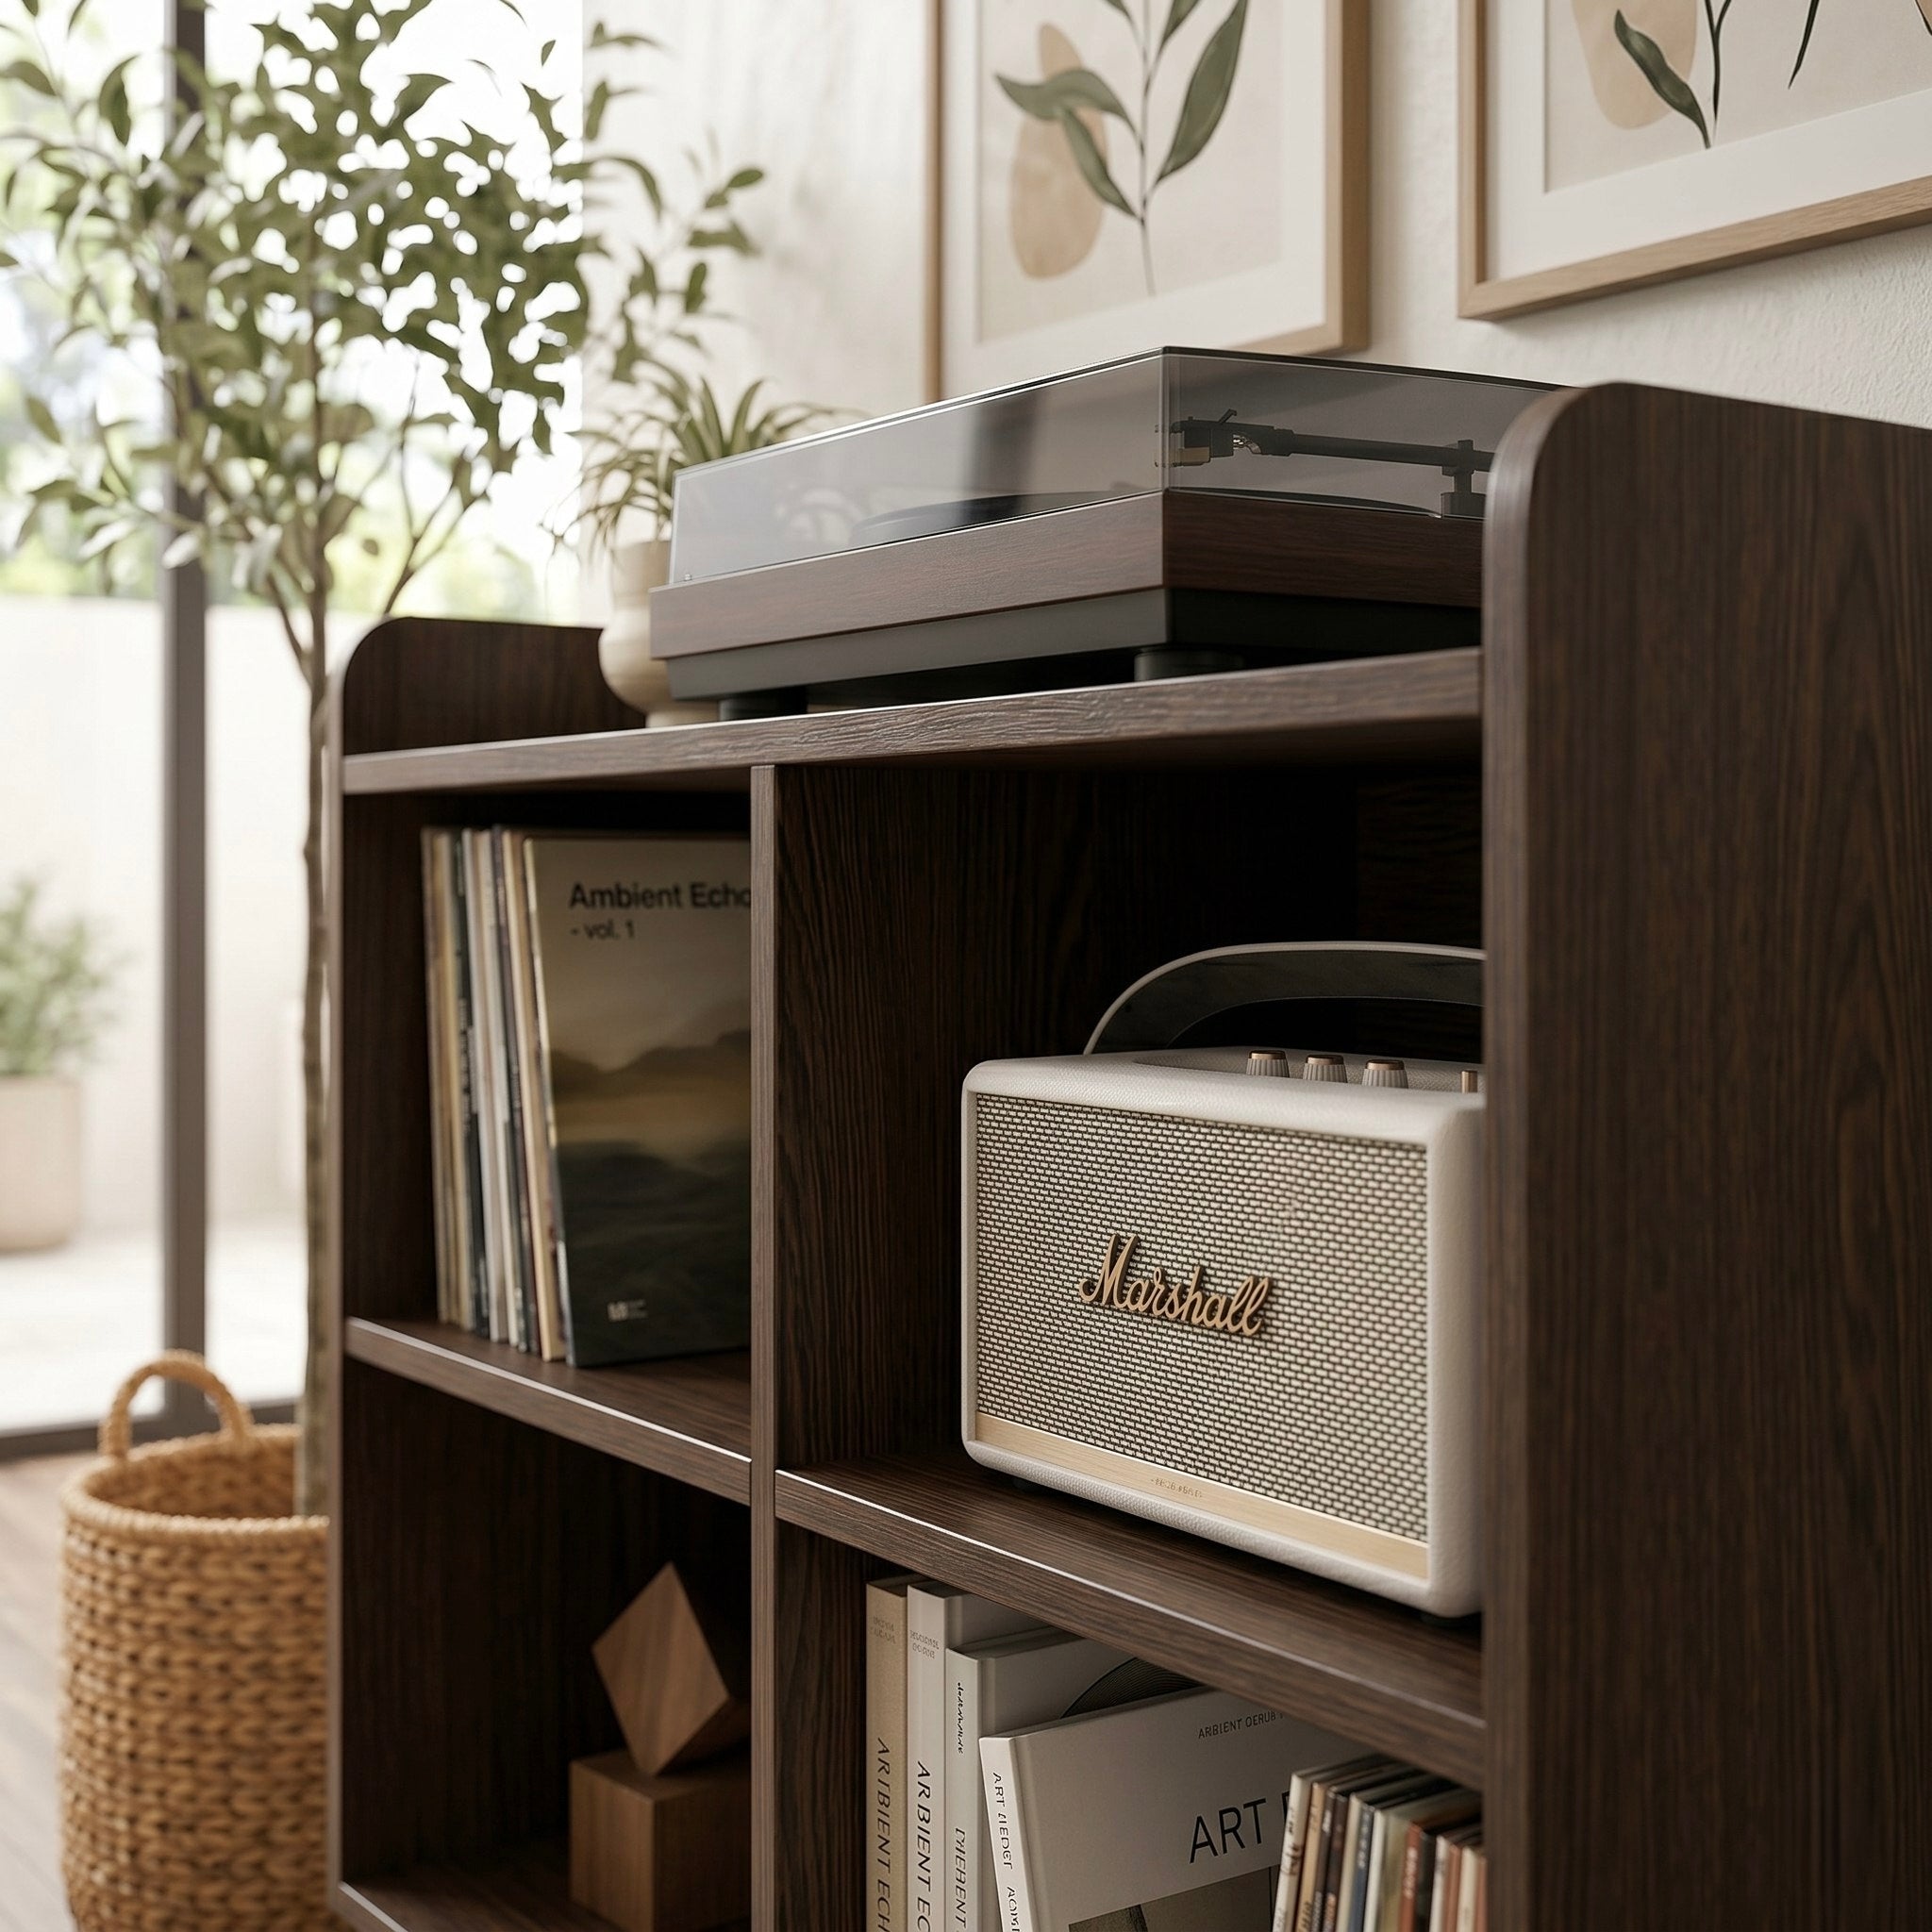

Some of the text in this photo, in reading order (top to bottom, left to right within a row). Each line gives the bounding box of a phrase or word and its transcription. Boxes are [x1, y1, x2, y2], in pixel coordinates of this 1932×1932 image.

[570, 882, 681, 908] Ambient
[625, 921, 635, 939] 1
[1078, 1233, 1271, 1337] Marshall
[1189, 1797, 1267, 1865] ART
